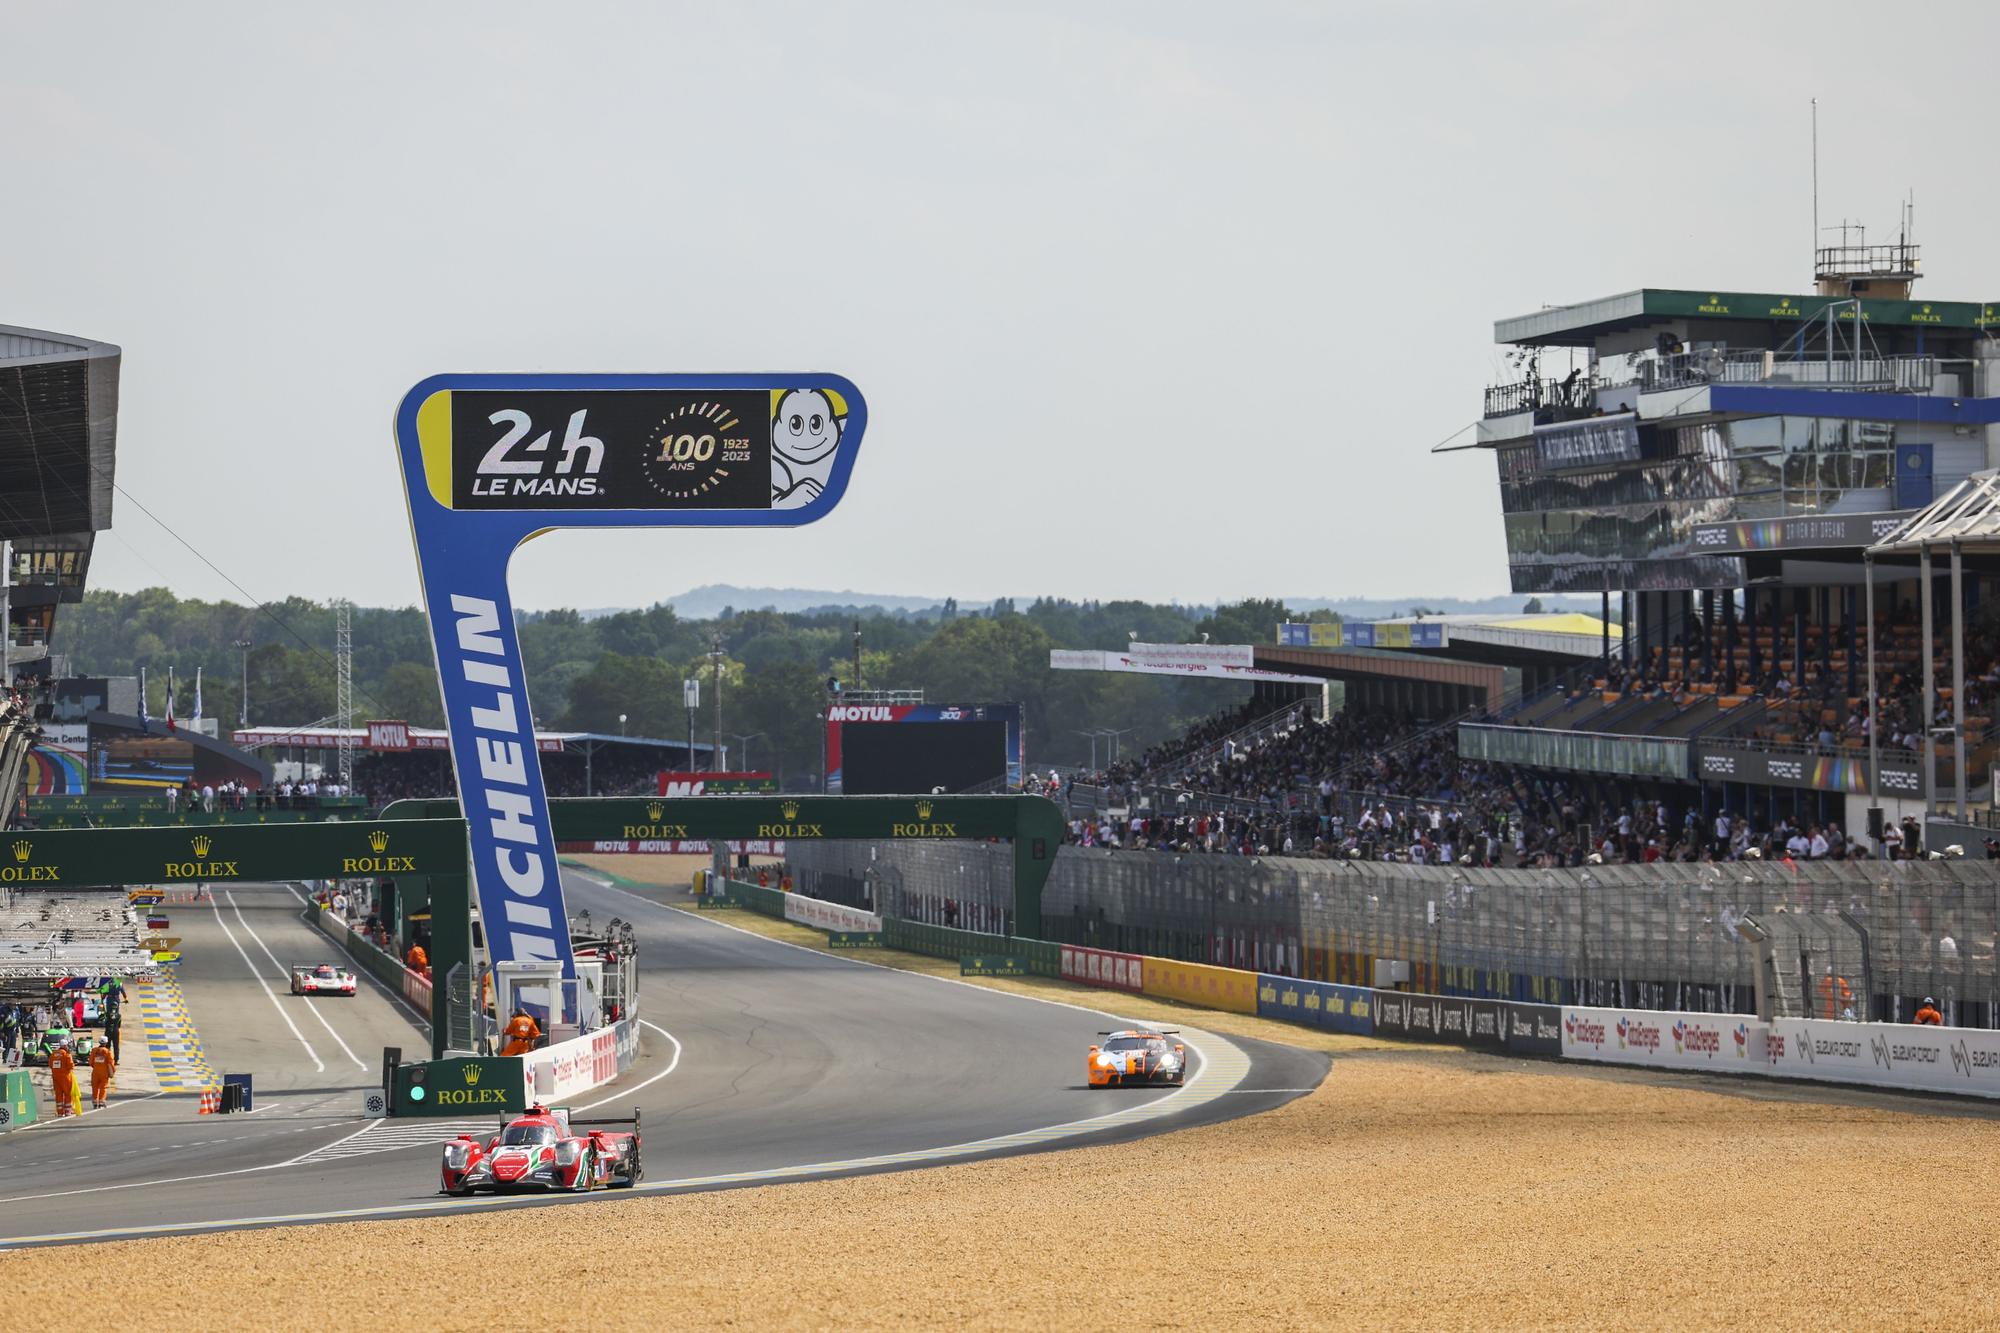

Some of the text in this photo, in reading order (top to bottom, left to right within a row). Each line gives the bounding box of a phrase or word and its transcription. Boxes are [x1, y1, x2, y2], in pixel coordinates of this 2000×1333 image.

[1698, 304, 1729, 314] ROLEX
[1769, 308, 1800, 317] ROLEX
[1912, 313, 1942, 322] ROLEX
[476, 409, 605, 474] 24h
[656, 434, 716, 461] 100
[723, 438, 750, 449] 1923
[722, 450, 751, 461] 2023
[668, 462, 696, 471] ANS
[471, 477, 598, 496] LE MANS
[1696, 528, 1727, 545] PORSCHE
[829, 706, 892, 722] MOTUL
[371, 724, 408, 747] MOTUL
[1703, 756, 1735, 774] PORSCHE
[1768, 760, 1802, 779] PORSCHE
[1880, 769, 1919, 790] PORSCHE
[450, 593, 566, 1009] MICHELIN
[623, 824, 688, 838] ROLEX
[758, 824, 823, 838] ROLEX
[893, 823, 957, 837] ROLEX
[594, 841, 629, 852] MOTUL
[638, 841, 671, 852] MOTUL
[678, 841, 709, 852] MOTUL
[745, 841, 770, 853] MOTUL
[165, 861, 239, 878] ROLEX
[343, 857, 416, 873] ROLEX
[159, 939, 168, 950] 14
[1815, 1039, 1862, 1058] SUZUKA CIRCUIT
[1892, 1044, 1941, 1063] SUZUKA CIRCUIT
[437, 1088, 507, 1105] ROLEX
